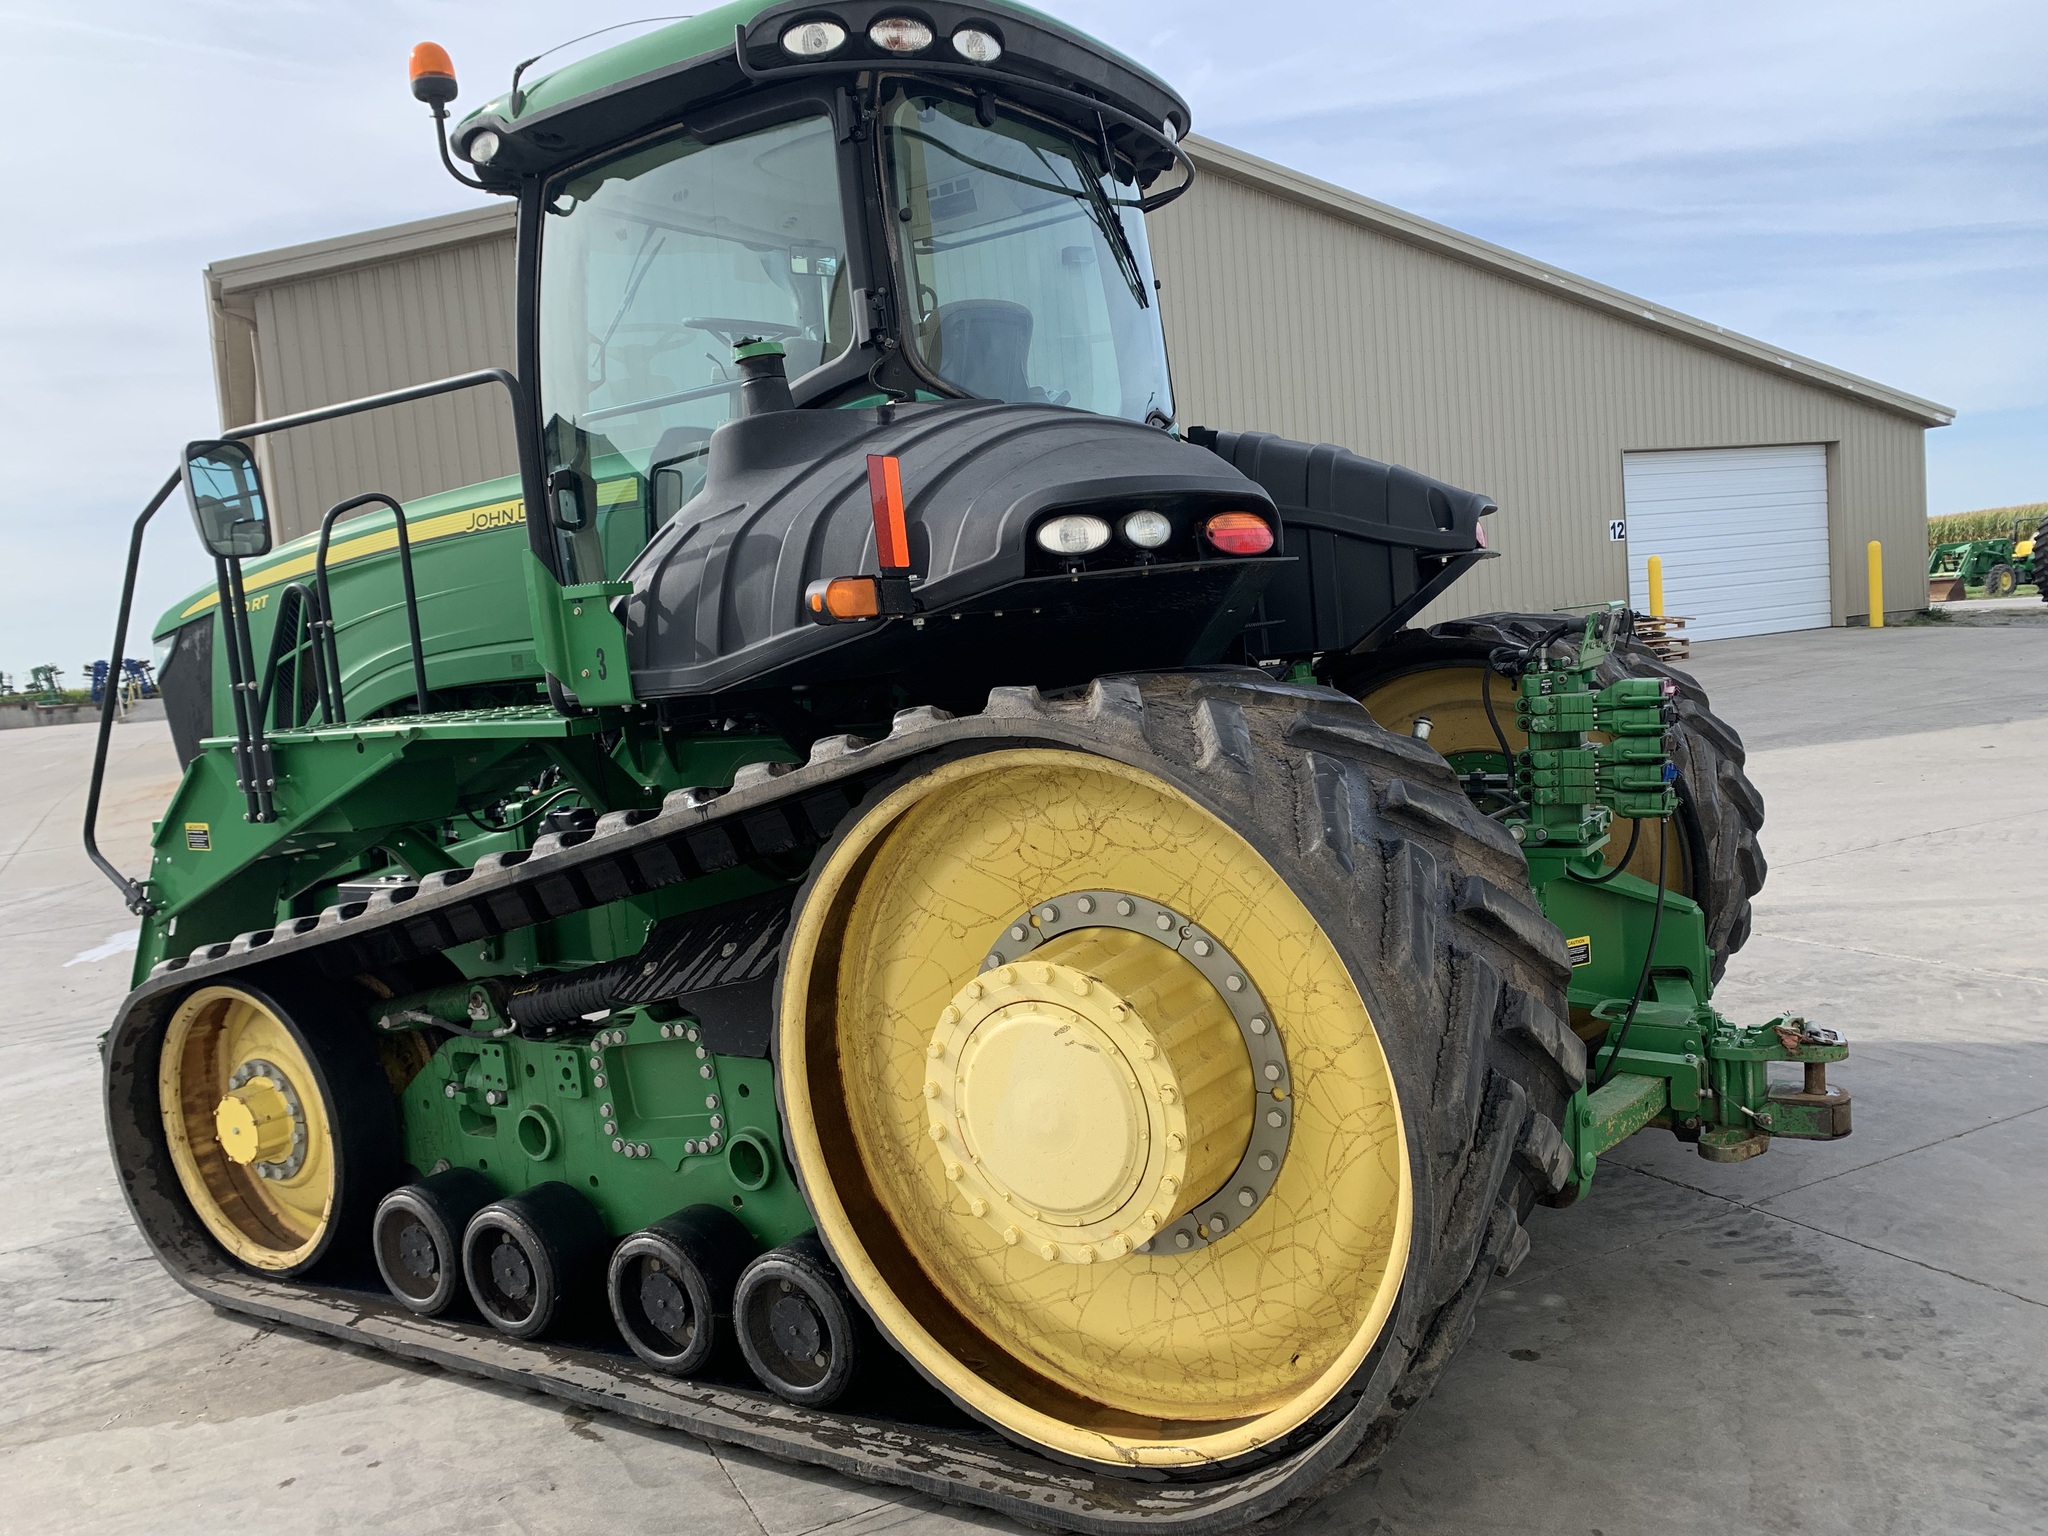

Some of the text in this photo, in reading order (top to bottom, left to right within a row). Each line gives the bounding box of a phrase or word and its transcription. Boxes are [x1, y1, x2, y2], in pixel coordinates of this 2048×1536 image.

[466, 508, 514, 531] JOHN
[1610, 521, 1625, 540] 12
[252, 594, 269, 612] RT
[596, 647, 607, 680] 3
